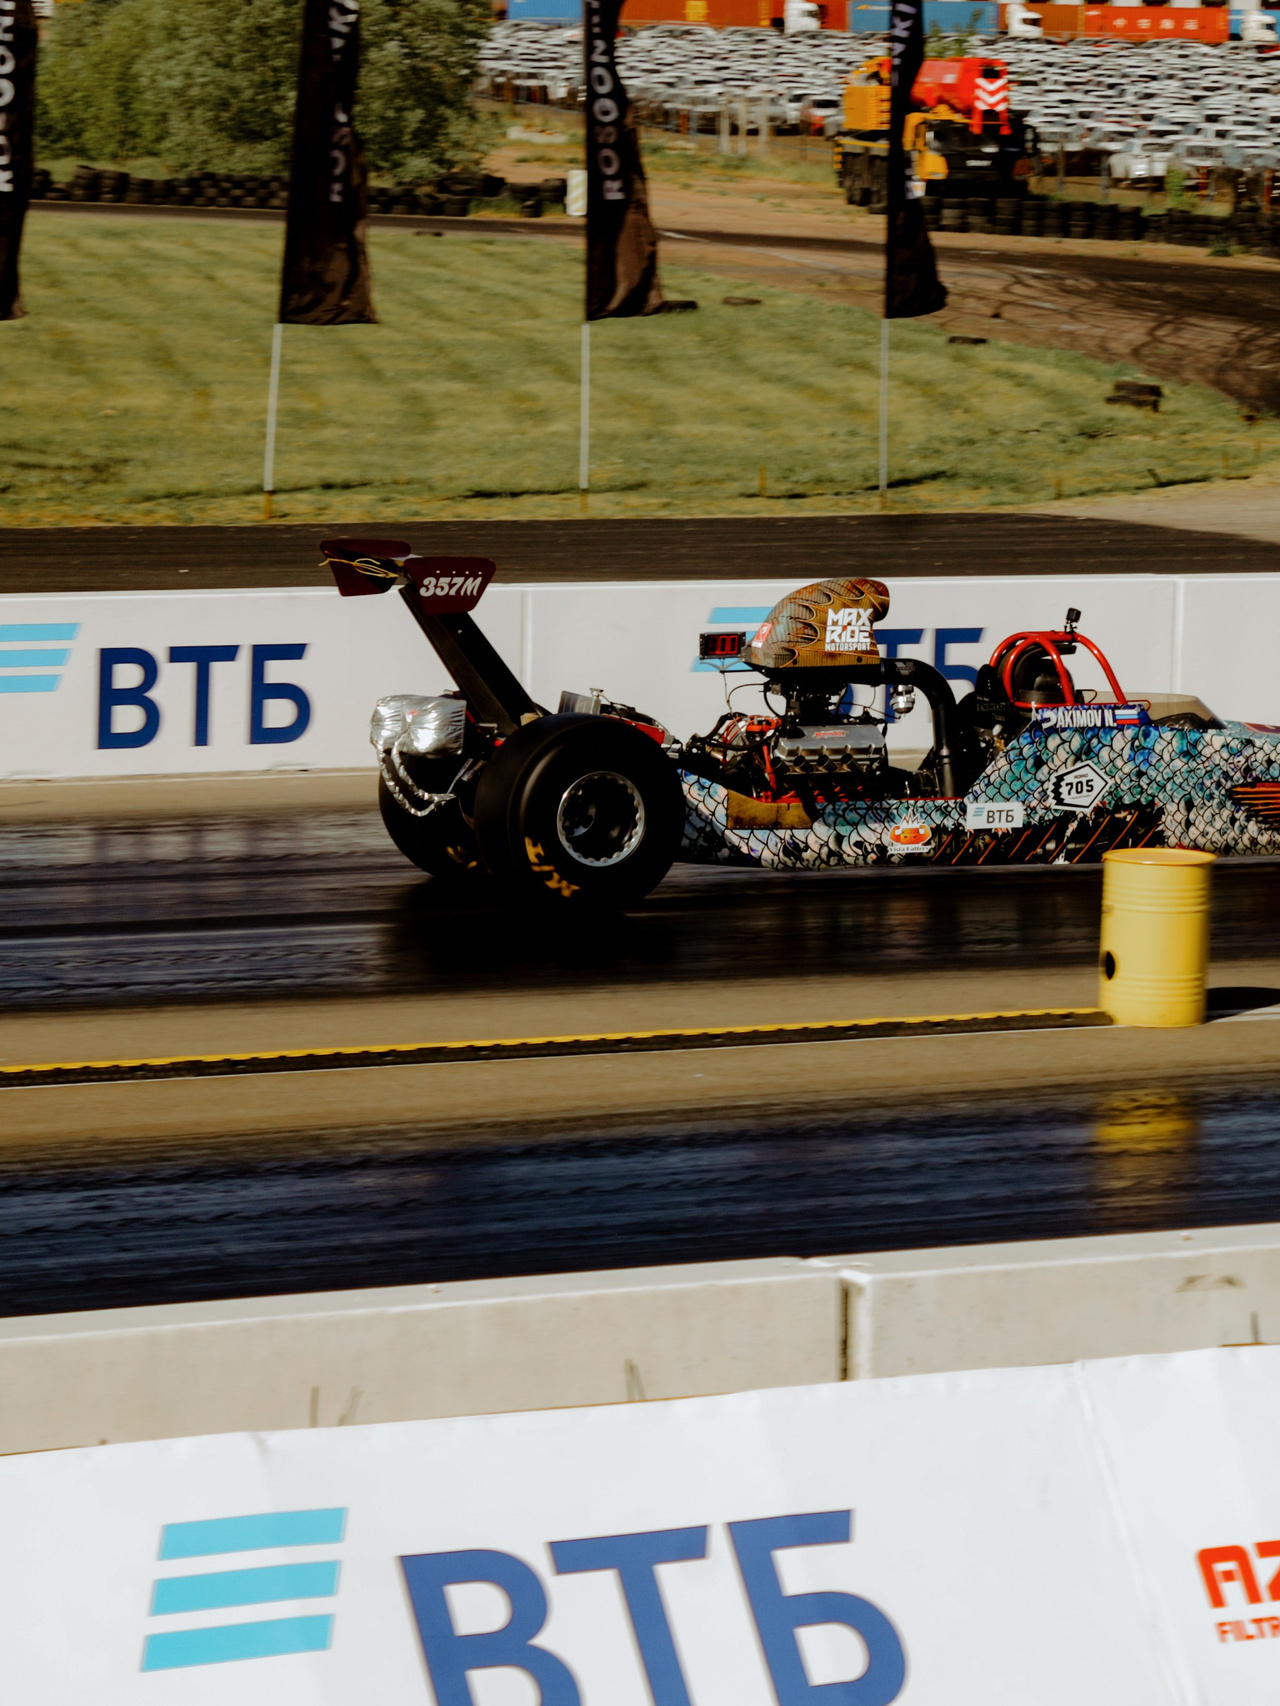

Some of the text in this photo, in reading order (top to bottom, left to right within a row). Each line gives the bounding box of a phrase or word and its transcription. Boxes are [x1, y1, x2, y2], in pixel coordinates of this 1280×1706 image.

[419, 576, 483, 598] 357M
[827, 608, 874, 626] MAX
[825, 642, 872, 652] MOTORSPORT
[97, 642, 312, 750] ВТБ
[1065, 779, 1095, 797] 705
[986, 809, 1015, 824] ВТБ
[397, 1509, 907, 1706] ВТБ
